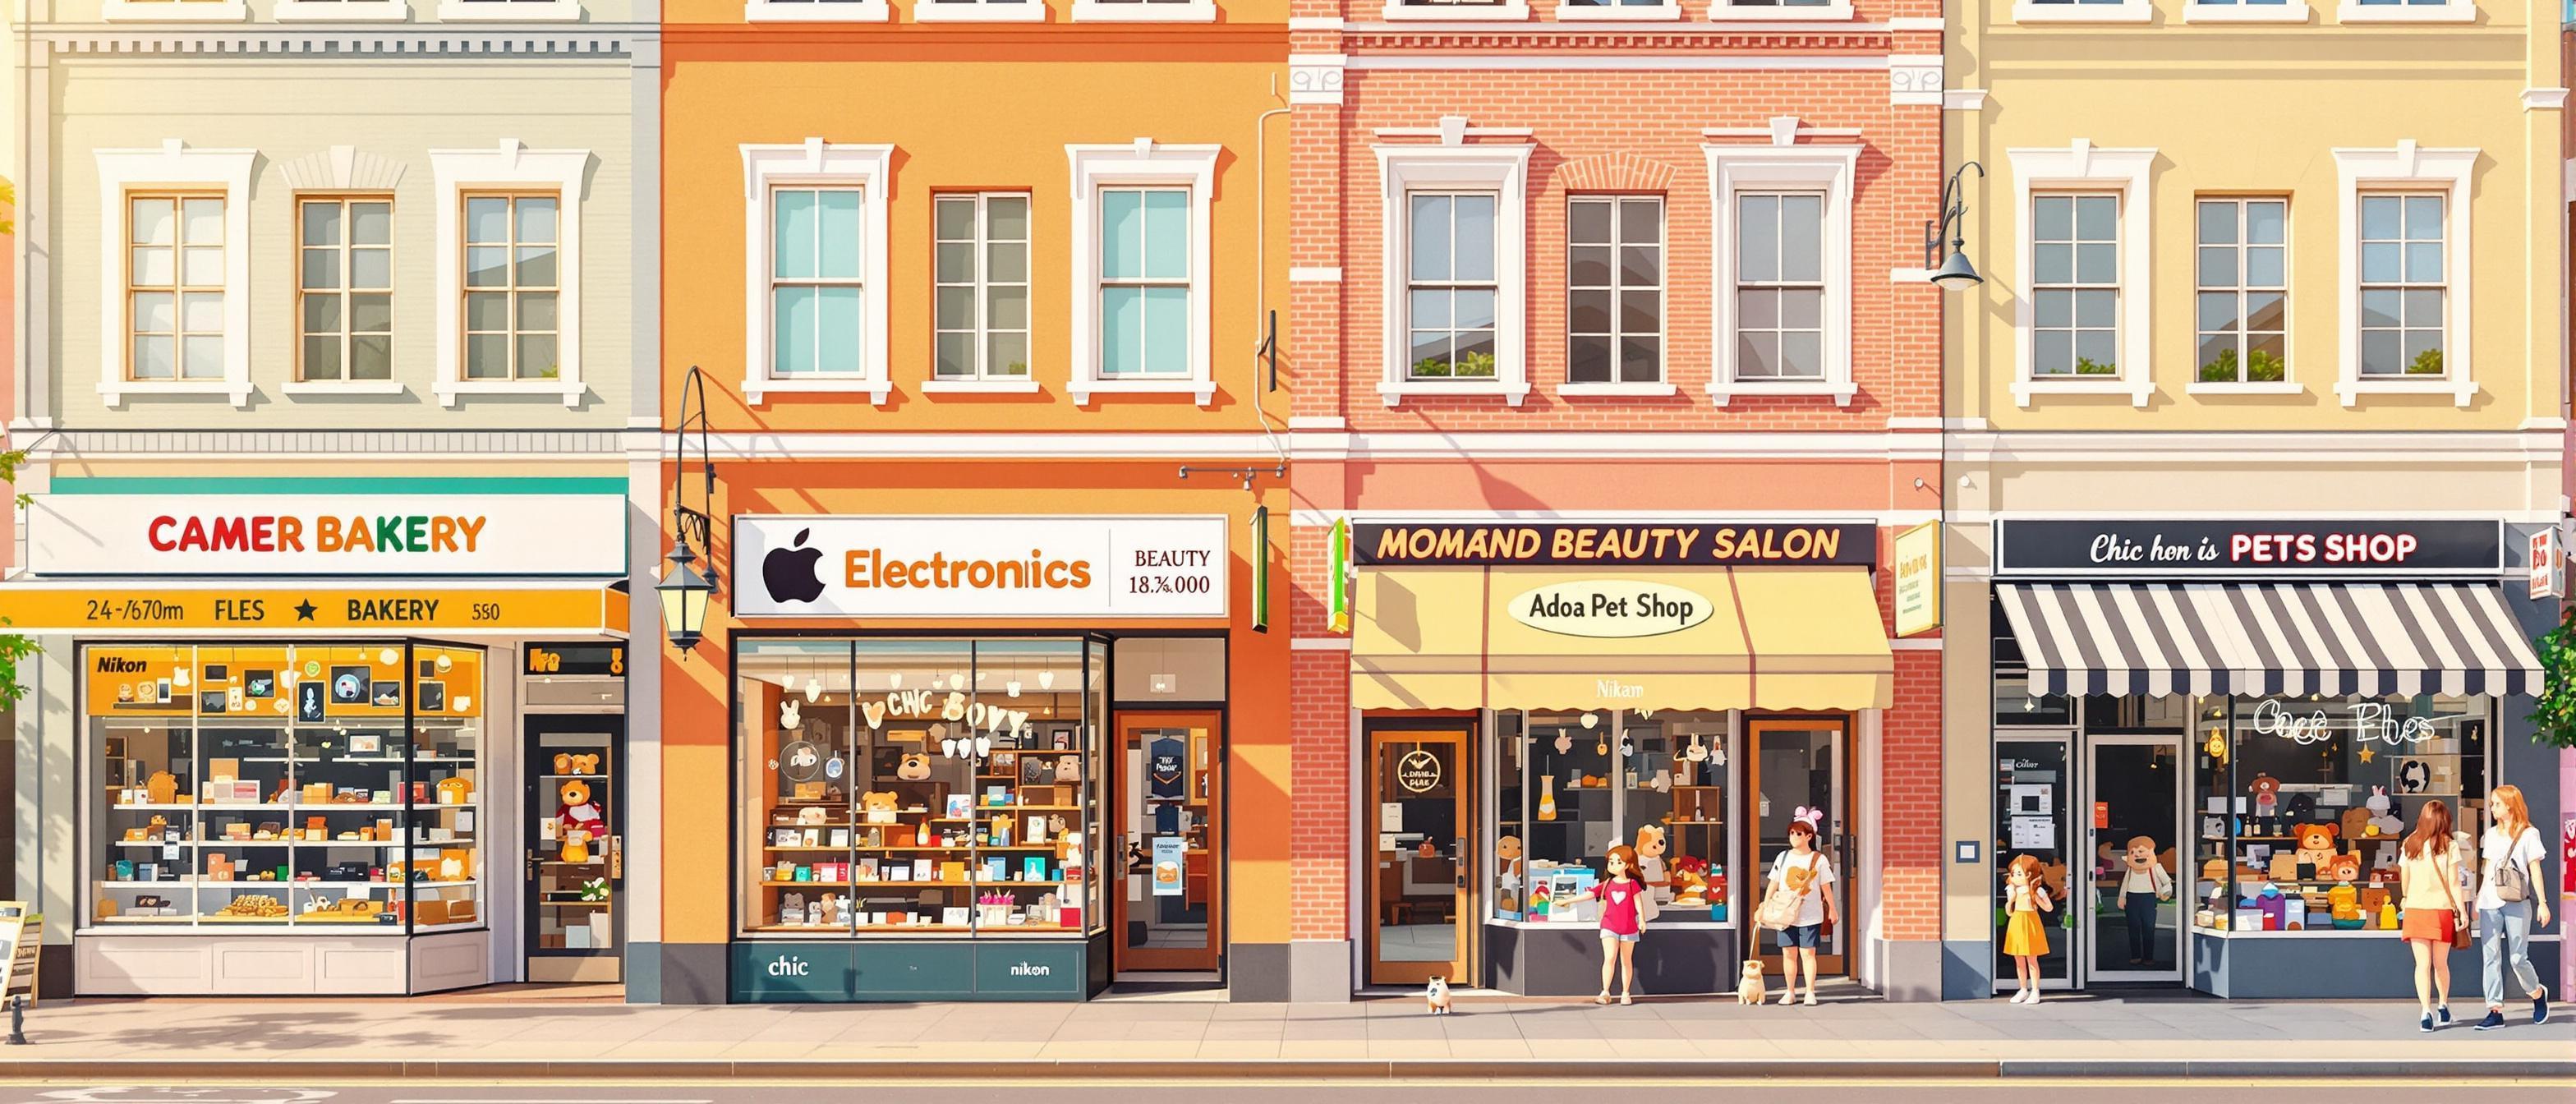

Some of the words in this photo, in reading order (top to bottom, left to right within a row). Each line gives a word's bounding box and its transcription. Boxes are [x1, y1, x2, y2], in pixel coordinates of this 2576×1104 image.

[148, 515, 304, 553] CAMER
[316, 515, 487, 553] BAKERY
[1377, 528, 1542, 559] MOMAND
[1550, 528, 1700, 559] BEAUTY
[1711, 528, 1841, 559] SALON
[1134, 550, 1211, 567] BEAUTY
[2090, 533, 2144, 563] Chic
[2196, 536, 2220, 562] is
[2229, 533, 2317, 564] PETS
[2322, 533, 2418, 564] SHOP
[215, 599, 265, 621] FLES
[347, 599, 439, 621] BAKERY
[1530, 593, 1585, 618] Adoa
[1591, 593, 1629, 618] Pet
[1635, 592, 1694, 625] Shop
[97, 656, 148, 673] Nikon
[768, 954, 809, 977] chic
[1010, 961, 1051, 976] nikon
